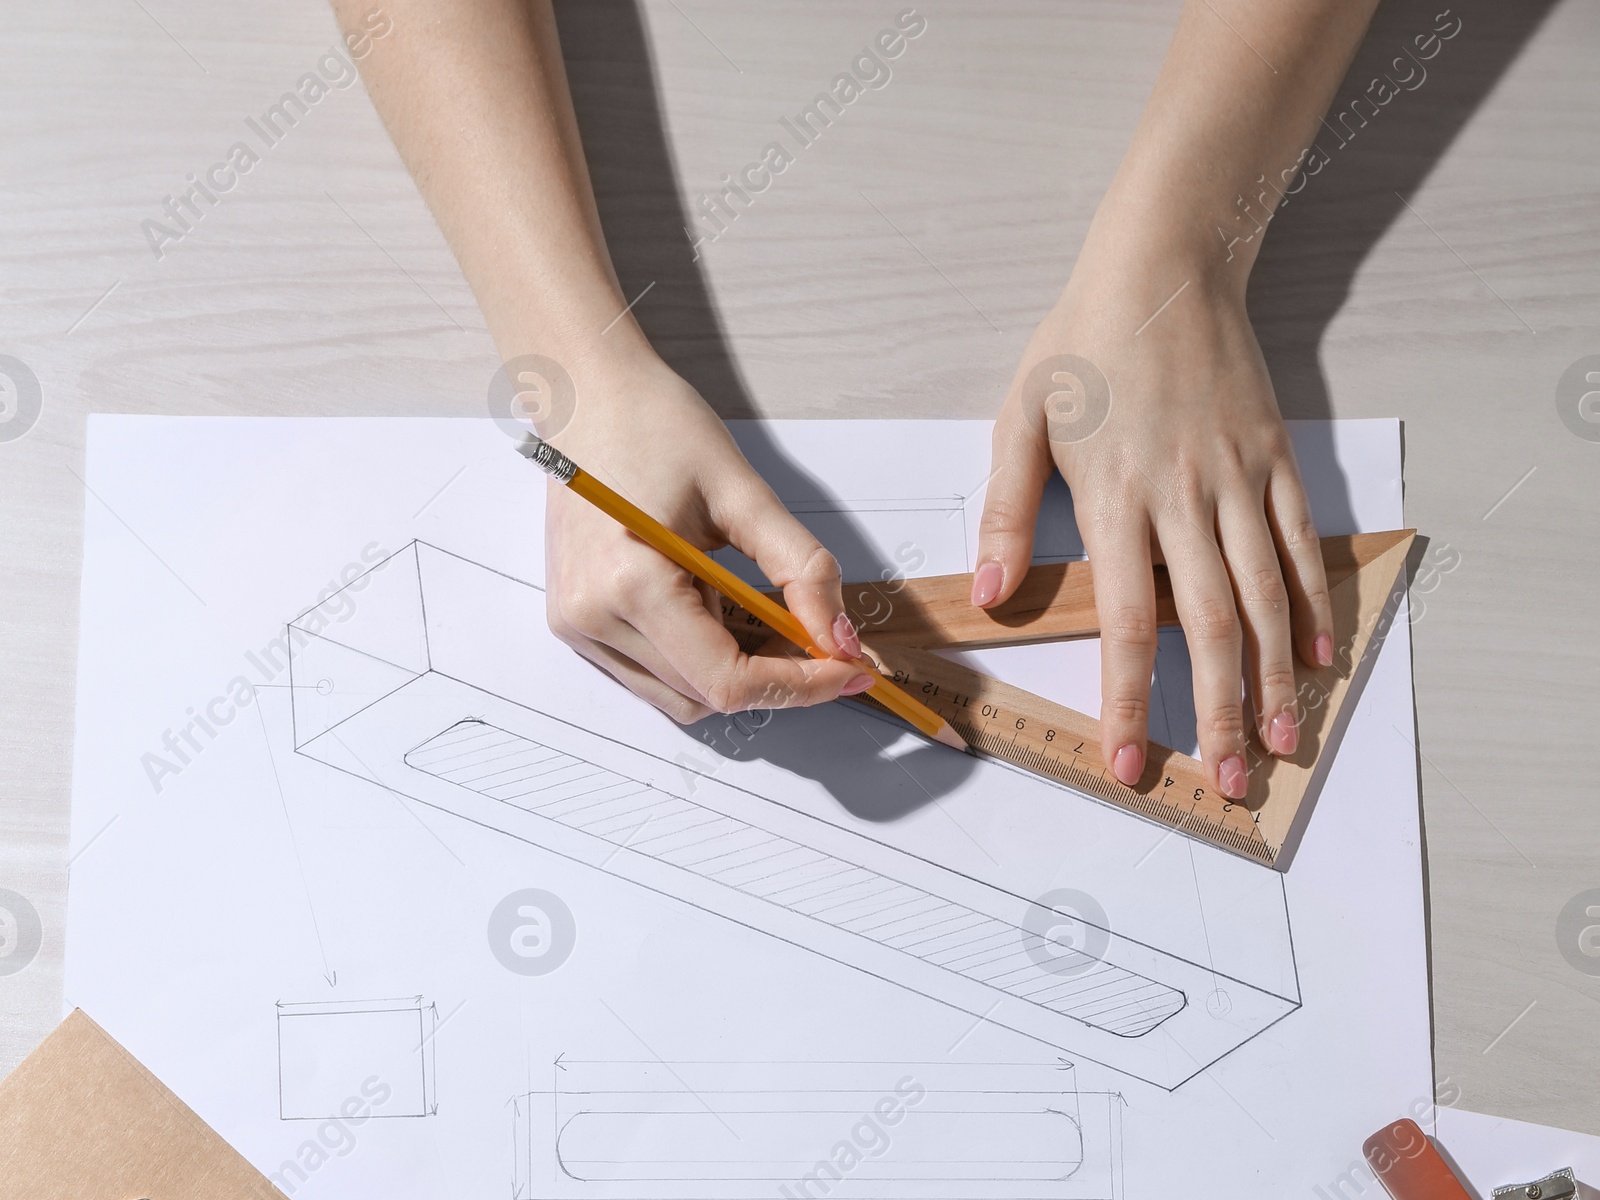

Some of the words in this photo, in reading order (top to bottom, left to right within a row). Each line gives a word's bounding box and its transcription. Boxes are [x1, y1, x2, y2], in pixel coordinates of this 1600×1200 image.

[892, 669, 910, 685] 13
[922, 681, 940, 696] 12
[953, 694, 970, 708] 11
[981, 704, 999, 719] 10
[1015, 717, 1027, 730] 9
[1045, 729, 1056, 742] 8
[1073, 742, 1085, 755] 7
[1164, 776, 1175, 788] 4
[1193, 788, 1205, 801] 3
[1222, 801, 1235, 813] 2
[1254, 812, 1261, 824] 1
